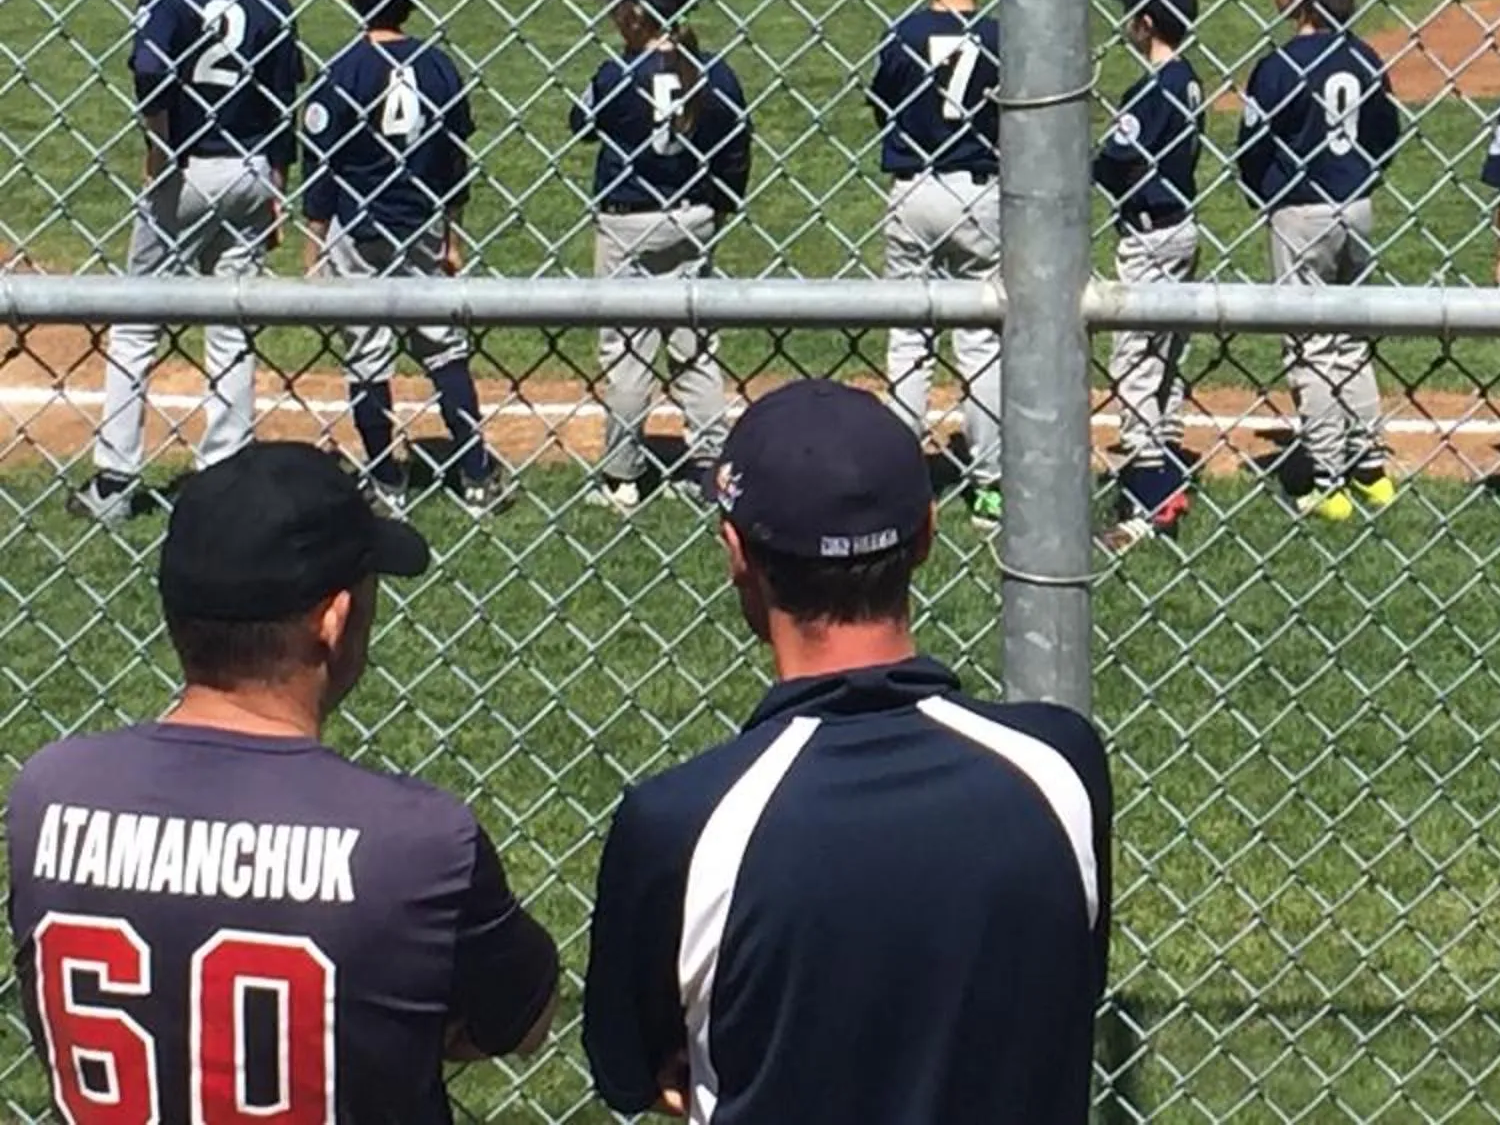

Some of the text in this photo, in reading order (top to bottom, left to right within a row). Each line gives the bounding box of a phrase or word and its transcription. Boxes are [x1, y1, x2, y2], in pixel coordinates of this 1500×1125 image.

[382, 65, 426, 145] 4
[928, 35, 981, 119] 7
[1324, 72, 1361, 156] 9
[33, 803, 361, 903] ATAMANCHUK
[33, 910, 337, 1125] 60
